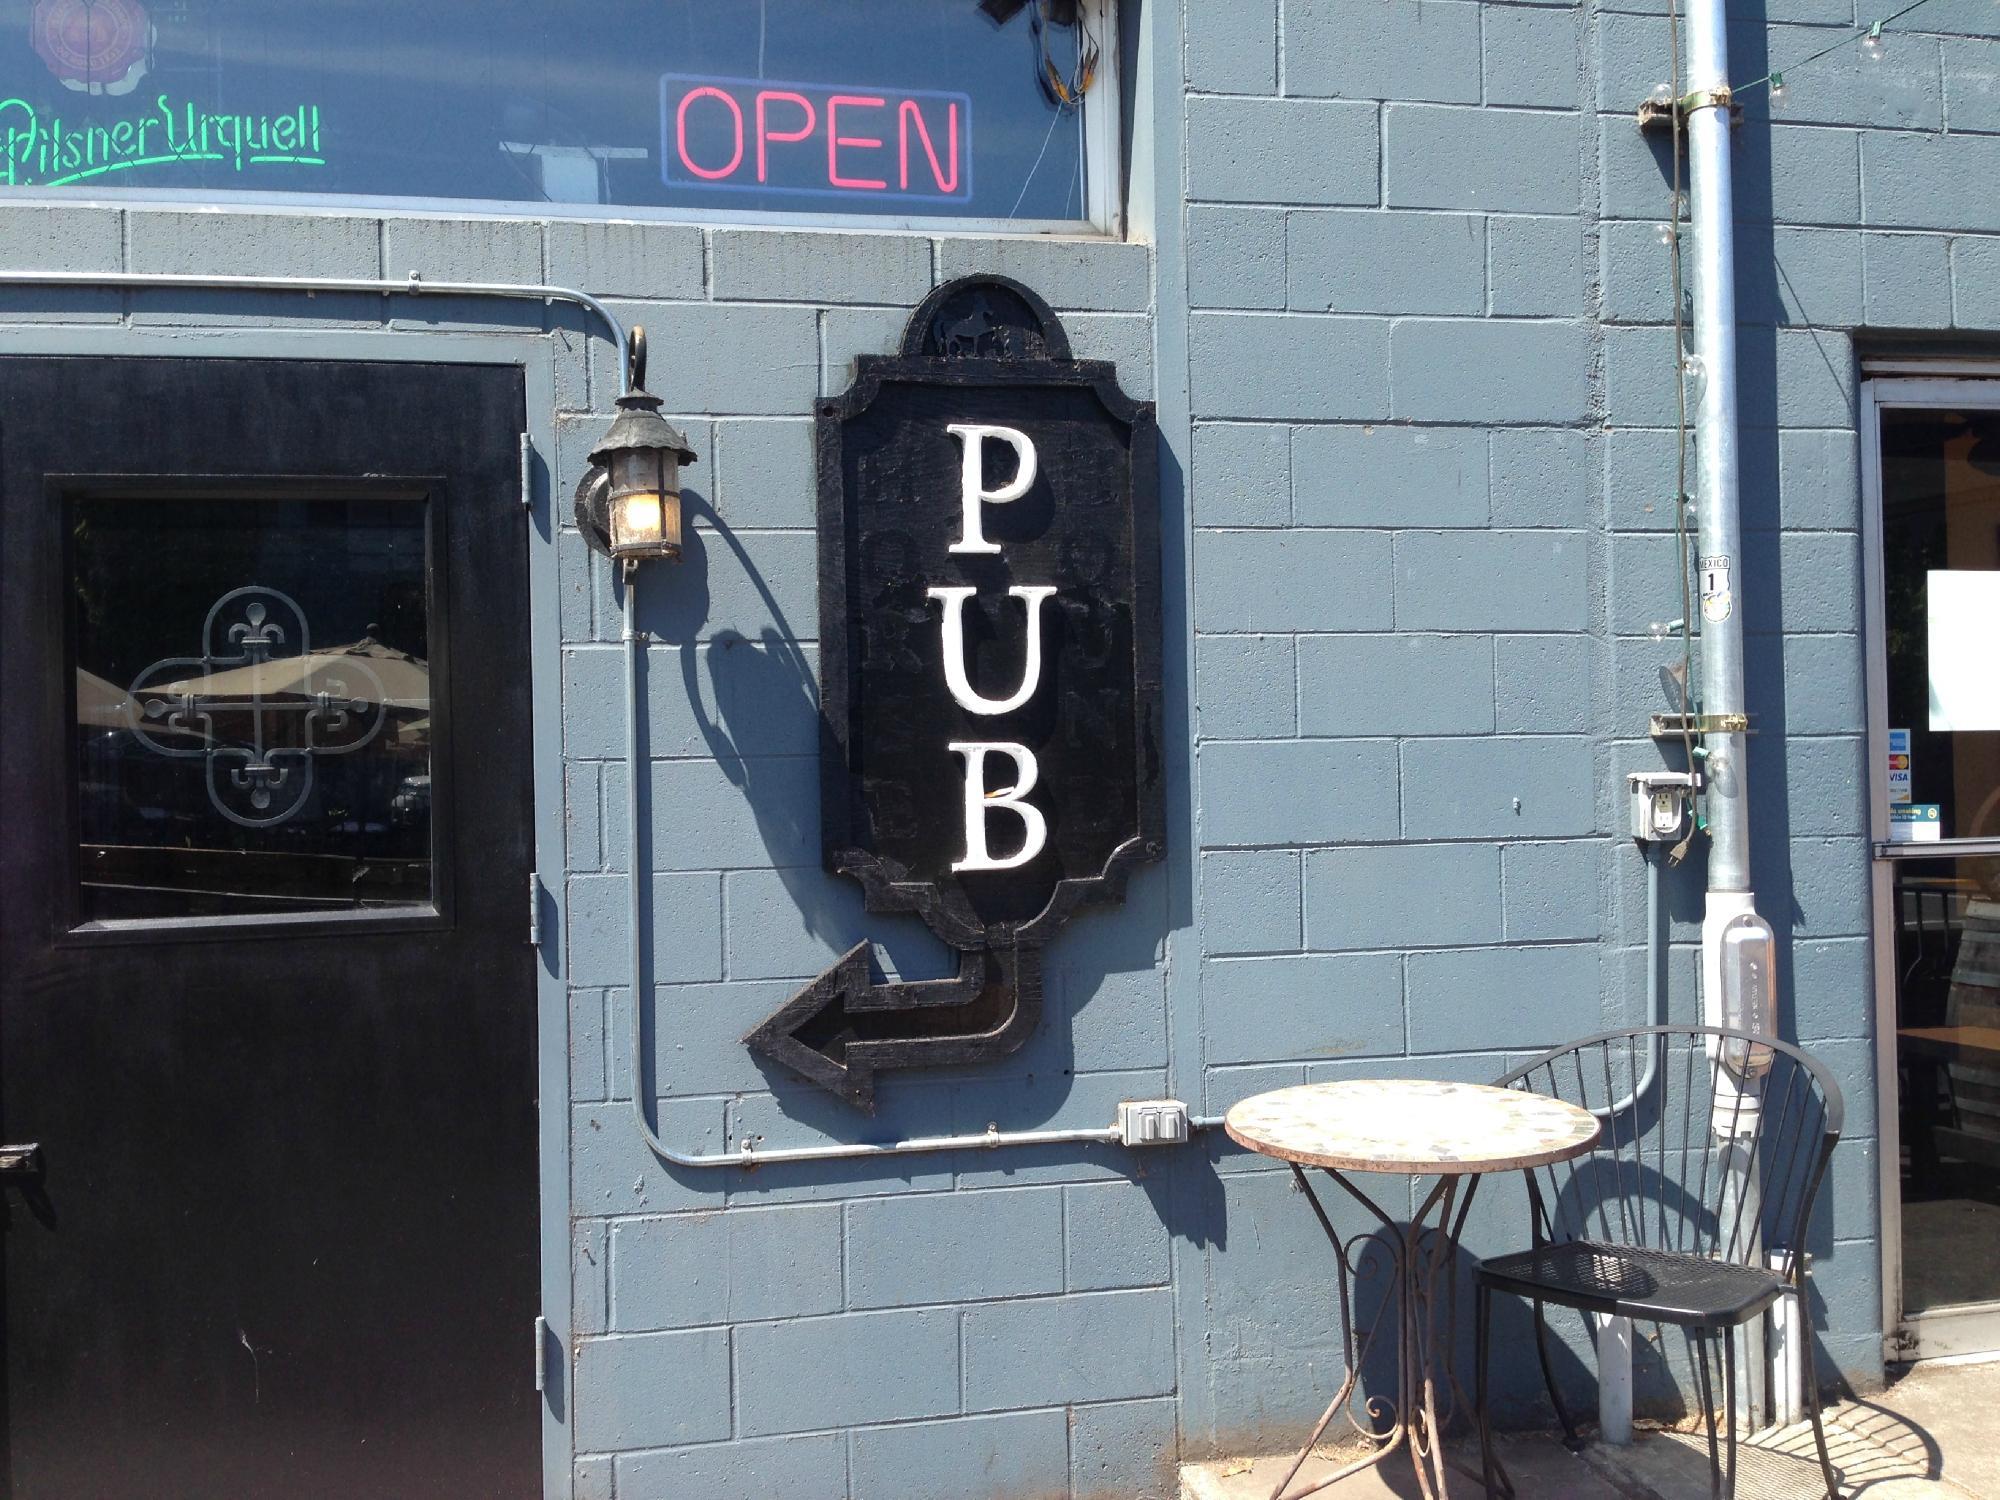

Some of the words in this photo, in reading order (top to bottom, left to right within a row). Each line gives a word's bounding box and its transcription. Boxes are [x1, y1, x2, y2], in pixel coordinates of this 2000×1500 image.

[0, 98, 159, 185] Pilsner
[158, 94, 320, 171] Urquell
[677, 86, 958, 193] OPEN
[1708, 572, 1714, 591] 1
[927, 423, 1058, 872] PUB
[1889, 773, 1908, 782] VISA
